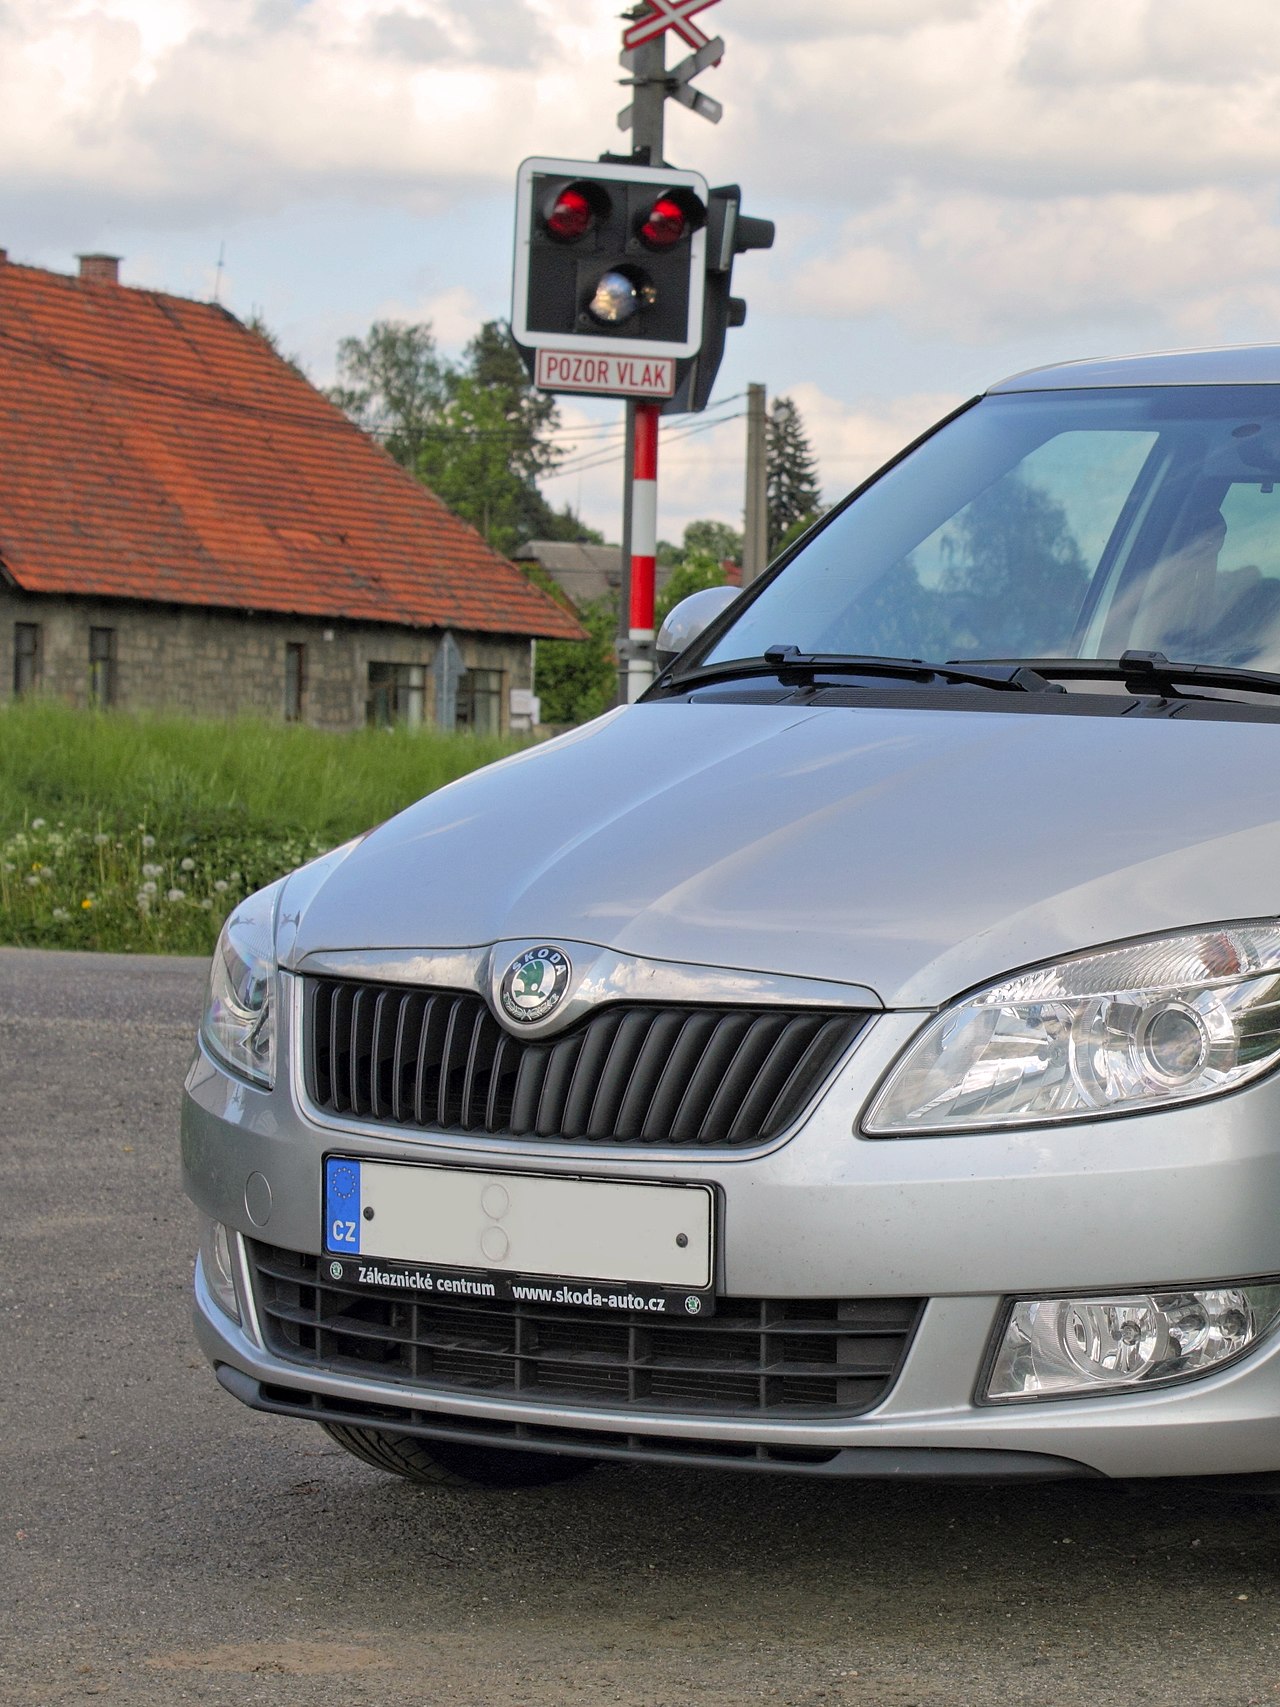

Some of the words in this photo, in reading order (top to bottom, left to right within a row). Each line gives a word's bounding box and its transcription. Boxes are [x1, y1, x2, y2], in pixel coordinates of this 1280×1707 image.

[547, 357, 608, 384] POZOR
[617, 361, 665, 388] VLAK
[333, 1219, 356, 1242] CZ
[358, 1266, 433, 1290] Zákaznické
[436, 1278, 496, 1296] centrum
[512, 1286, 665, 1311] www.skoda-auto.cz
